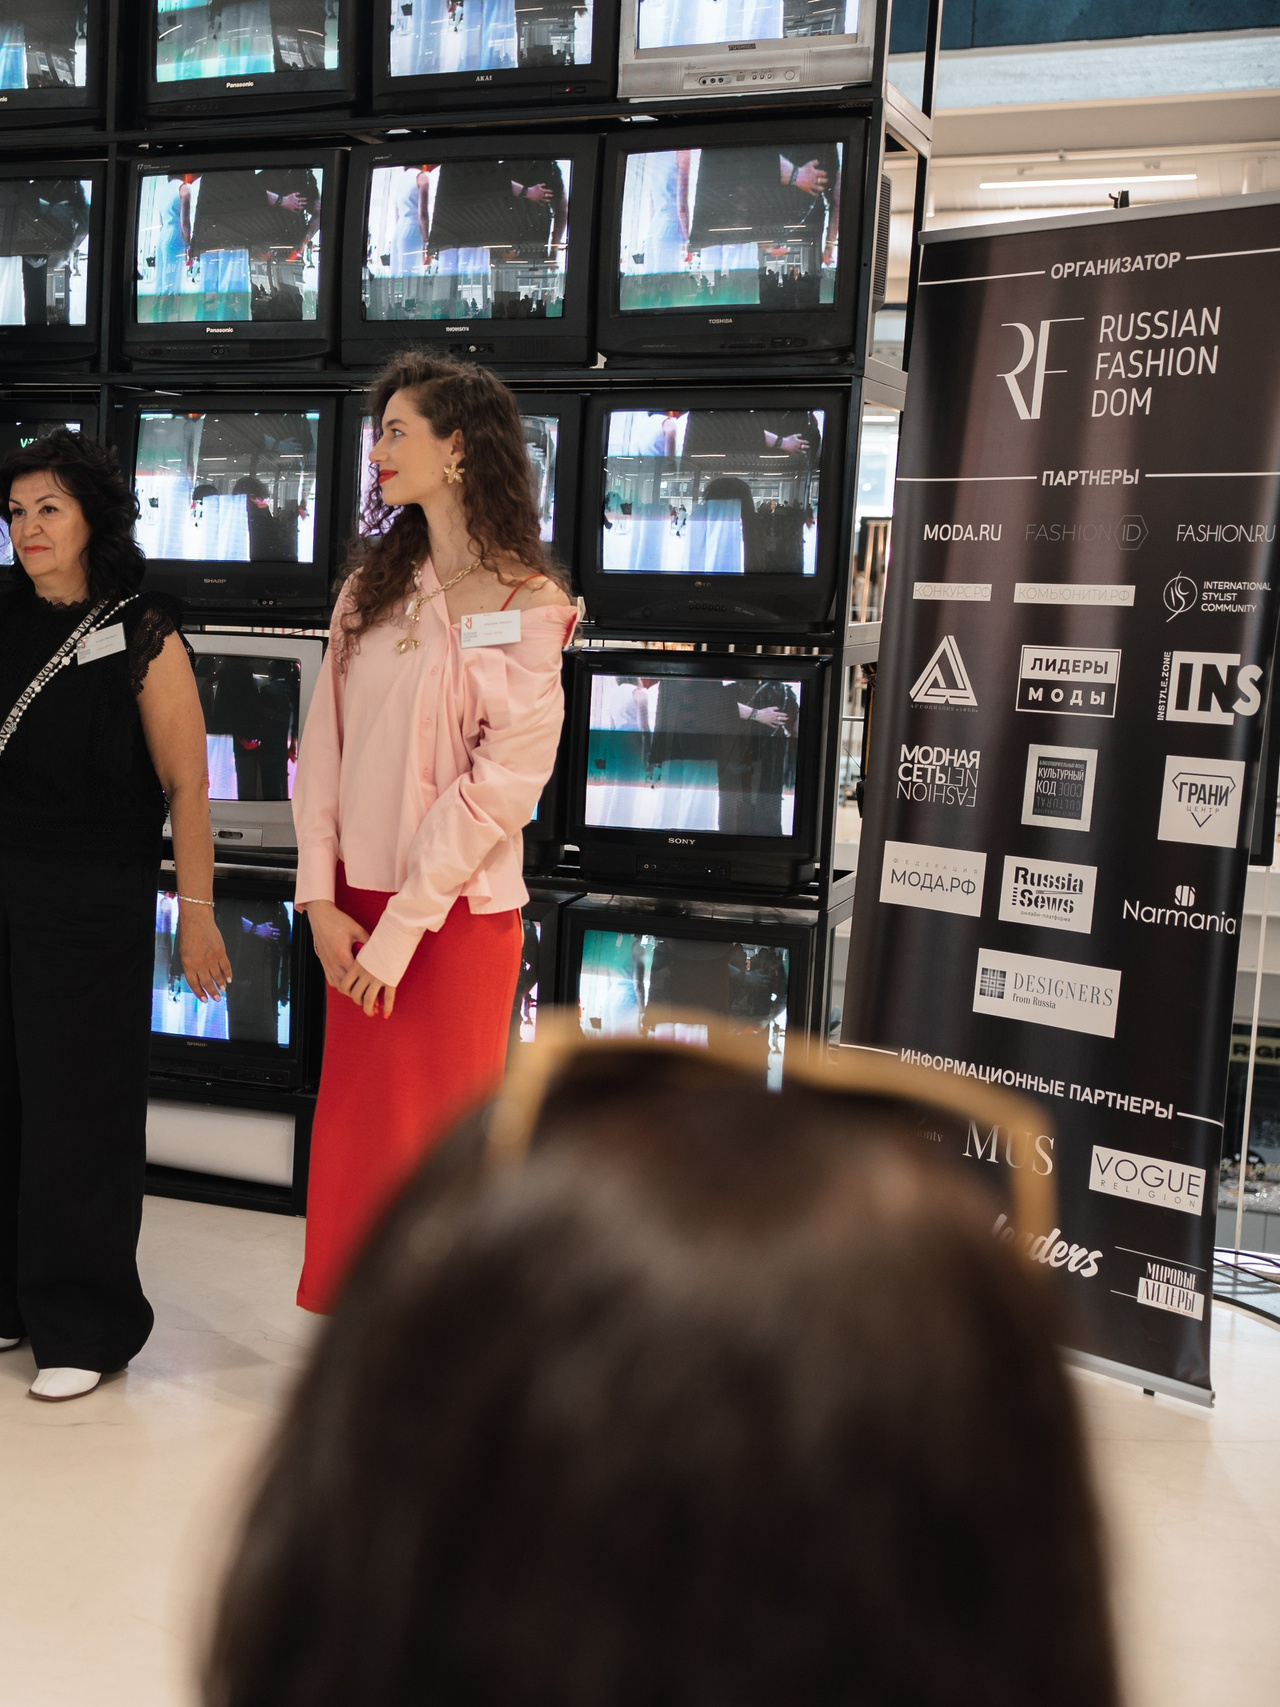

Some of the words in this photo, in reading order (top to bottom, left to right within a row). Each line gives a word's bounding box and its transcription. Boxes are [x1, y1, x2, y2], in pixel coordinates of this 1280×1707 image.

[1051, 252, 1180, 280] ОРГАНИЗАТОР
[1099, 306, 1221, 343] RUSSIAN
[1095, 345, 1218, 380] FASHION
[1091, 387, 1152, 418] DOM
[1042, 469, 1139, 486] ПАРТНЕРЫ
[923, 524, 1002, 541] MODA.RU
[1025, 524, 1111, 541] FASHION
[1122, 524, 1142, 542] ID
[1176, 524, 1276, 543] FASHION.RU
[914, 583, 991, 599] КОНКУРС.РФ
[1019, 586, 1130, 603] КОМЬЮНИТИ.РФ
[1202, 592, 1238, 601] STYLIST
[1203, 581, 1272, 591] INTERNATIONAL
[1201, 603, 1257, 613] COMMUNITY
[1030, 656, 1109, 676] ЛИДЕРЫ
[1028, 686, 1106, 706] МОДЫ
[1156, 651, 1172, 721] INSTYLE.ZONE
[1165, 650, 1264, 726] INS
[897, 762, 946, 785] СЕТЬ
[1038, 767, 1085, 781] КУЛЬТУРНЫЙ
[896, 780, 977, 808] FASHION
[1036, 780, 1057, 797] КОД
[1177, 782, 1231, 807] ГРАНИ
[1186, 806, 1220, 814] ЦЕНТР
[668, 837, 696, 845] SONY
[892, 858, 978, 874] ФЕДЕРАЦИЯ
[890, 868, 977, 895] МОДА.РФ
[1013, 866, 1084, 893] Russia
[1019, 888, 1074, 914] Sews
[1020, 910, 1071, 923] онлайн-платформа
[1122, 899, 1237, 935] Narmania
[1013, 972, 1113, 1007] DESIGNERS
[1012, 993, 1031, 1005] from
[1032, 996, 1056, 1010] Russia
[900, 1046, 1065, 1098] ИНФОРМАЦИОННЫЕ
[1069, 1082, 1173, 1120] ПАРТНЕРЫ
[1095, 1152, 1201, 1198] VOGUE
[1100, 1179, 1195, 1208] RELIGION
[1146, 1261, 1199, 1291] МИРОВЫЕ
[1141, 1280, 1196, 1313] ЛИДЕРЫ
